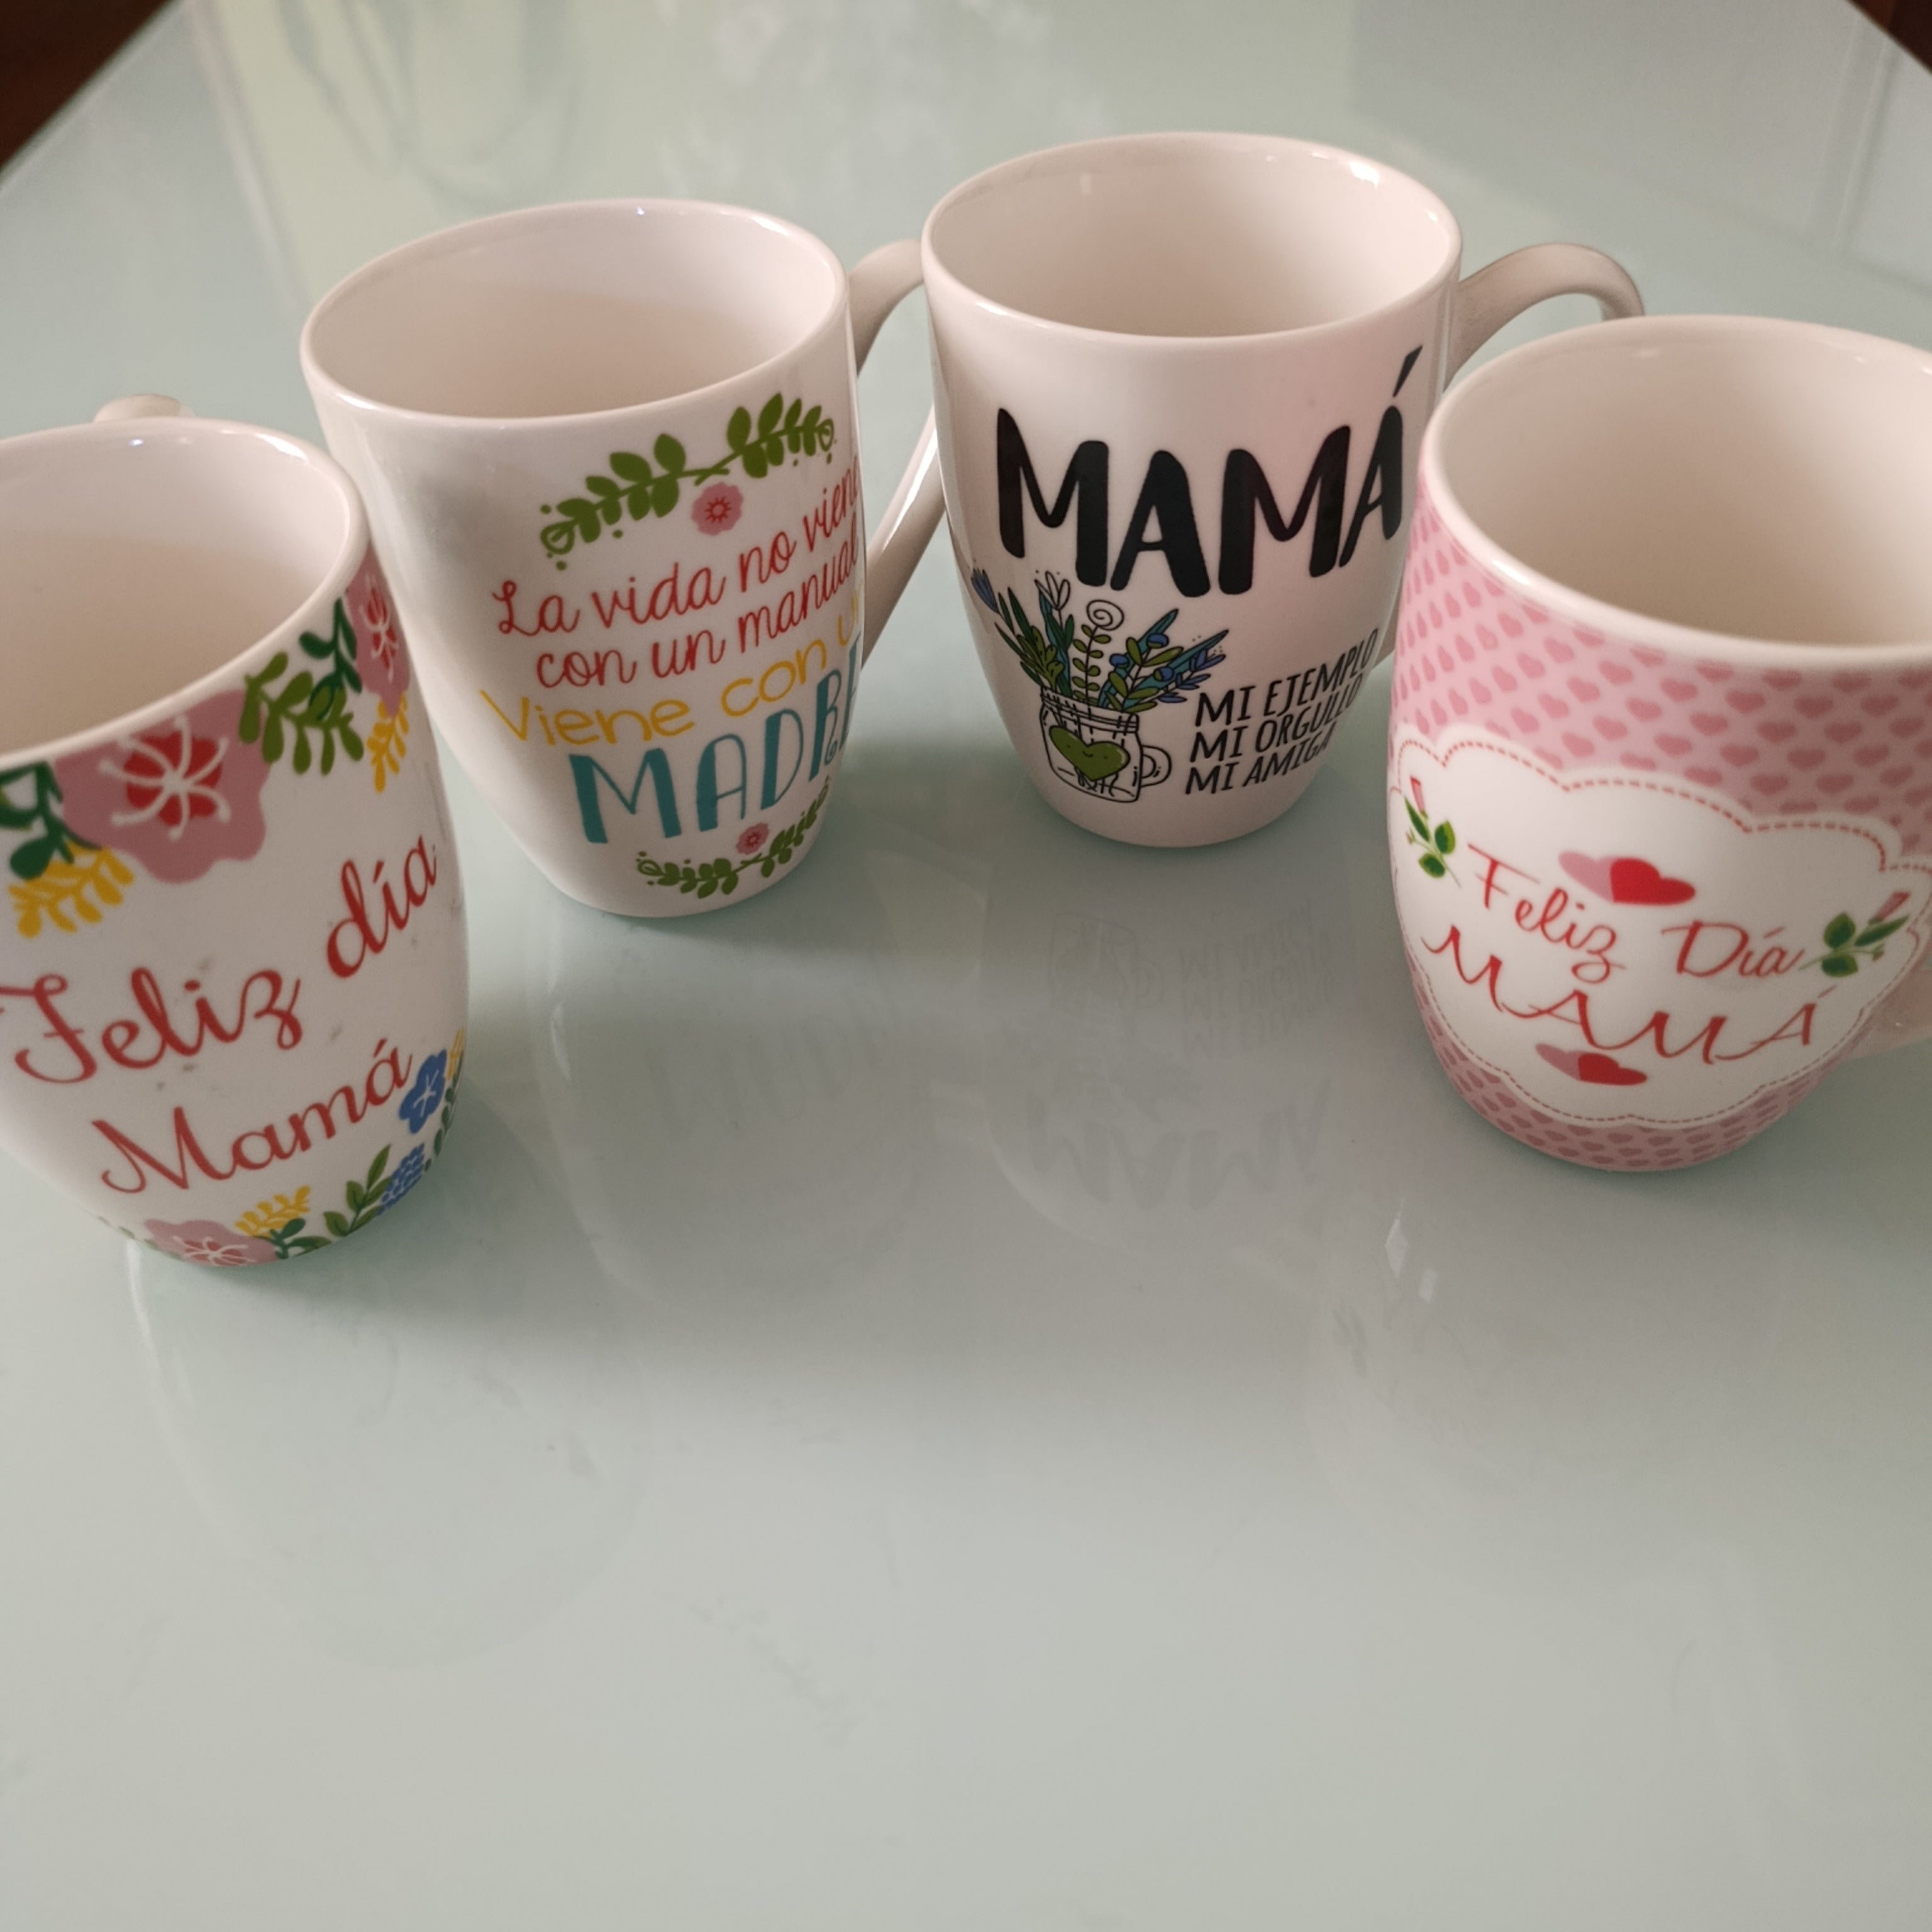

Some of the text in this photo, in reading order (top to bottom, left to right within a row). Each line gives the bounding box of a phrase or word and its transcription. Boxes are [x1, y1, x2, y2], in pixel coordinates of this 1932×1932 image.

[997, 345, 1423, 597] MAMÁ
[492, 579, 581, 637] La
[591, 562, 727, 629] vida
[738, 530, 797, 593] no
[536, 512, 859, 689] con un manual
[719, 638, 828, 718] con
[1189, 672, 1365, 763] MI ORGULLO
[1194, 628, 1379, 727] MI EJEMPLO
[1185, 720, 1337, 795] MI AMIGA
[0, 835, 438, 1084] Feliz día
[1467, 843, 1806, 984] Feliz Día
[1420, 924, 1838, 1065] MAMÁ
[91, 1038, 413, 1195] Mamá
